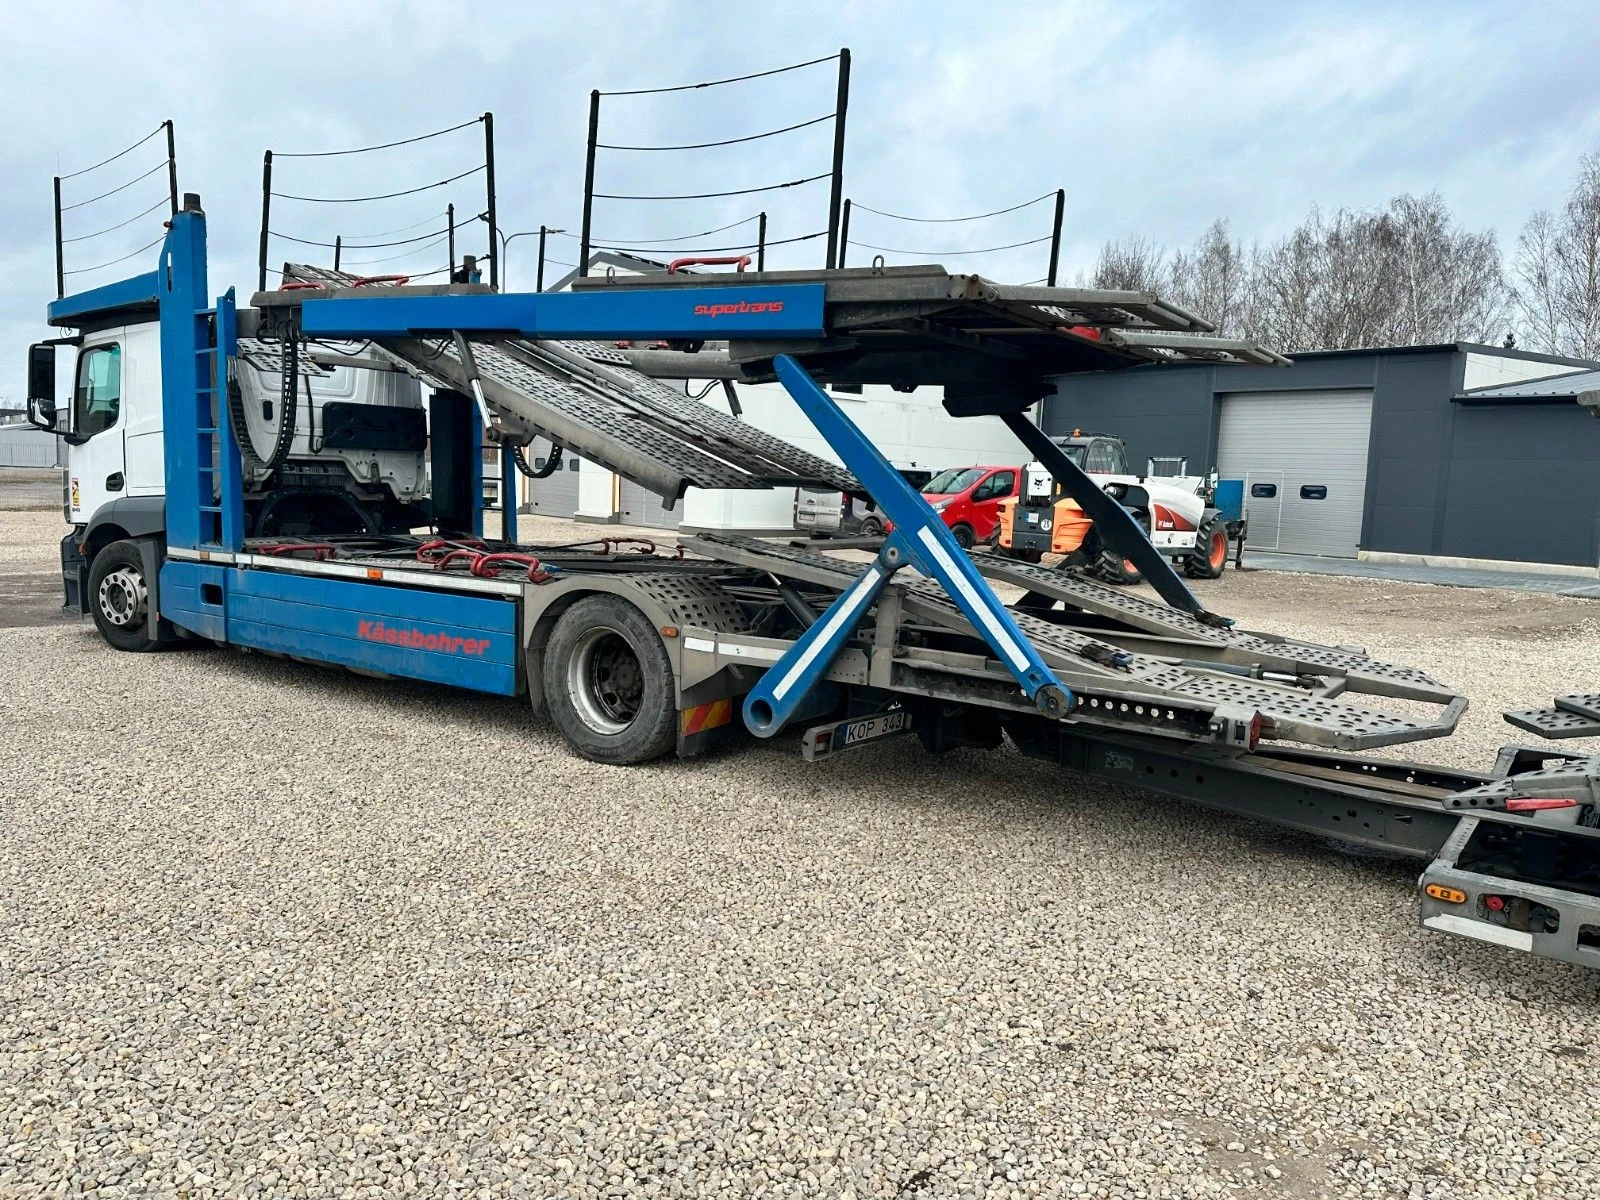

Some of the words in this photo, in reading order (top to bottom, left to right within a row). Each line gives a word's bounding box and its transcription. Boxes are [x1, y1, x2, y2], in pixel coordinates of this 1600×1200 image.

[694, 301, 784, 319] supertrans
[356, 618, 491, 656] Kässbohrer
[847, 721, 875, 742] KOP
[881, 714, 902, 733] 343
